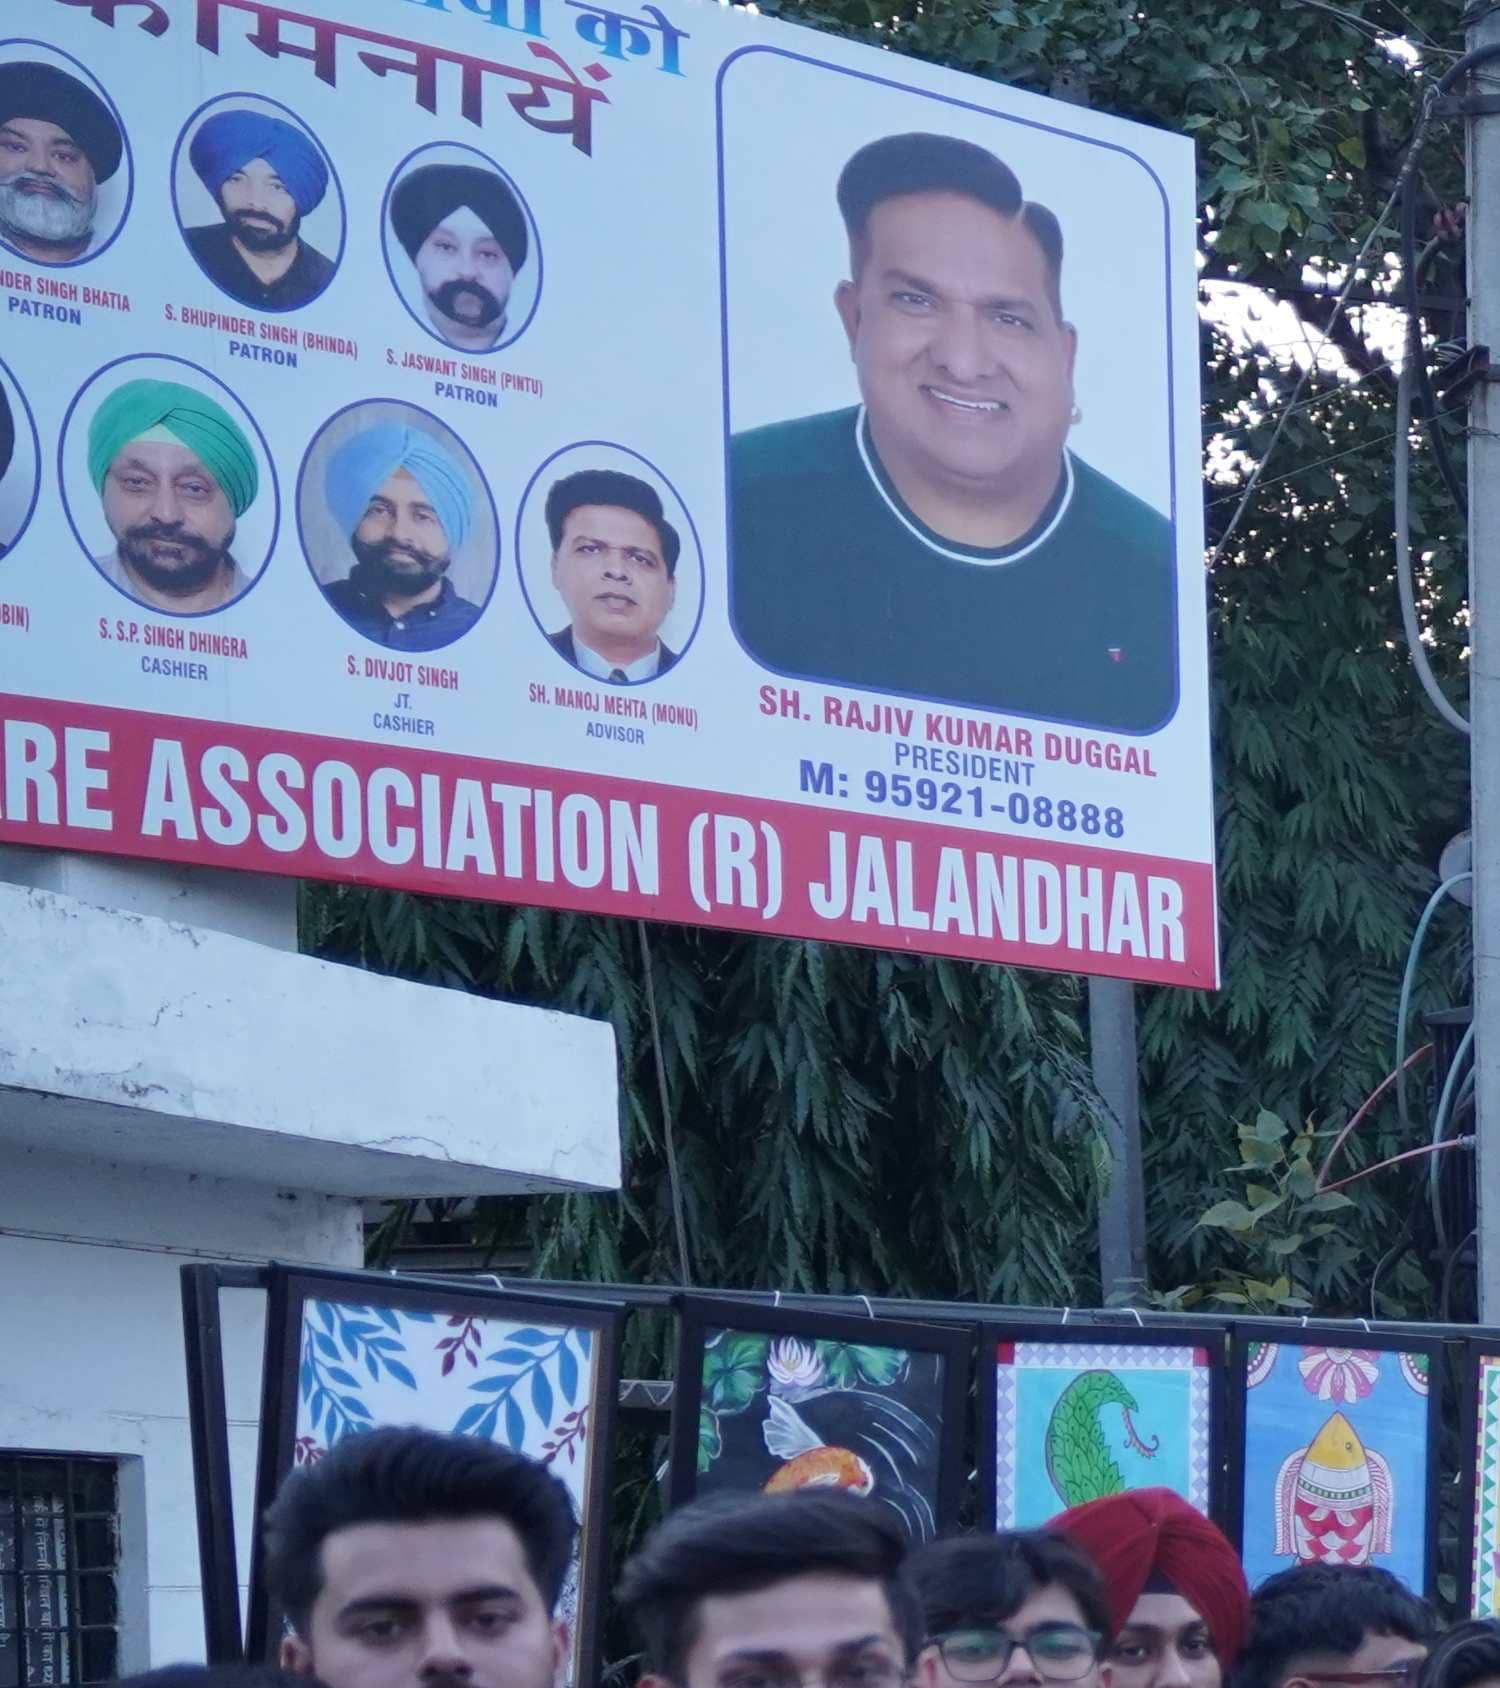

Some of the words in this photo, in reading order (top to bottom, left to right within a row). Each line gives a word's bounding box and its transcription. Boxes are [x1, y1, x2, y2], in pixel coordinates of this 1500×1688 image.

[8, 296, 82, 326] PATRON
[36, 277, 78, 301] SINGH
[82, 287, 131, 312] BHATIA
[165, 304, 177, 321] S.
[181, 306, 255, 336] BHUPINDER
[259, 323, 298, 346] SINGH
[303, 331, 358, 360] (BHINDA)
[229, 340, 298, 368] PATRON
[386, 348, 398, 366] S.
[401, 352, 457, 378] JASWANT
[461, 364, 497, 385] SINGH
[501, 372, 543, 398] (PINTU)
[435, 382, 498, 408] PATRON
[99, 618, 112, 640] S.
[116, 620, 140, 644] S.P.
[143, 624, 184, 650] SINGH
[189, 632, 248, 659] DHINGRA
[141, 655, 208, 680] CASHIER
[347, 654, 361, 677] S.
[364, 660, 413, 684] DIVJOT
[417, 666, 459, 691] SINGH
[393, 693, 413, 711] JT.
[528, 683, 551, 705] SH.
[554, 687, 600, 713] MANOJ
[604, 695, 648, 720] MEHTA
[651, 702, 699, 732] (MONU)
[373, 713, 435, 736] CASHIER
[586, 722, 645, 745] ADVISOR
[758, 683, 812, 722] SH.
[823, 695, 914, 737] RAJIV
[925, 716, 1034, 759] KUMAR
[1044, 732, 1158, 778] DUGGAL
[894, 742, 1036, 788] PRESIDENT
[799, 759, 850, 798] M:
[864, 769, 1126, 839] 95921-08888
[140, 736, 658, 898] ASSOCIATION
[688, 811, 782, 920] (R)
[808, 830, 1186, 963] JALANDHAR
